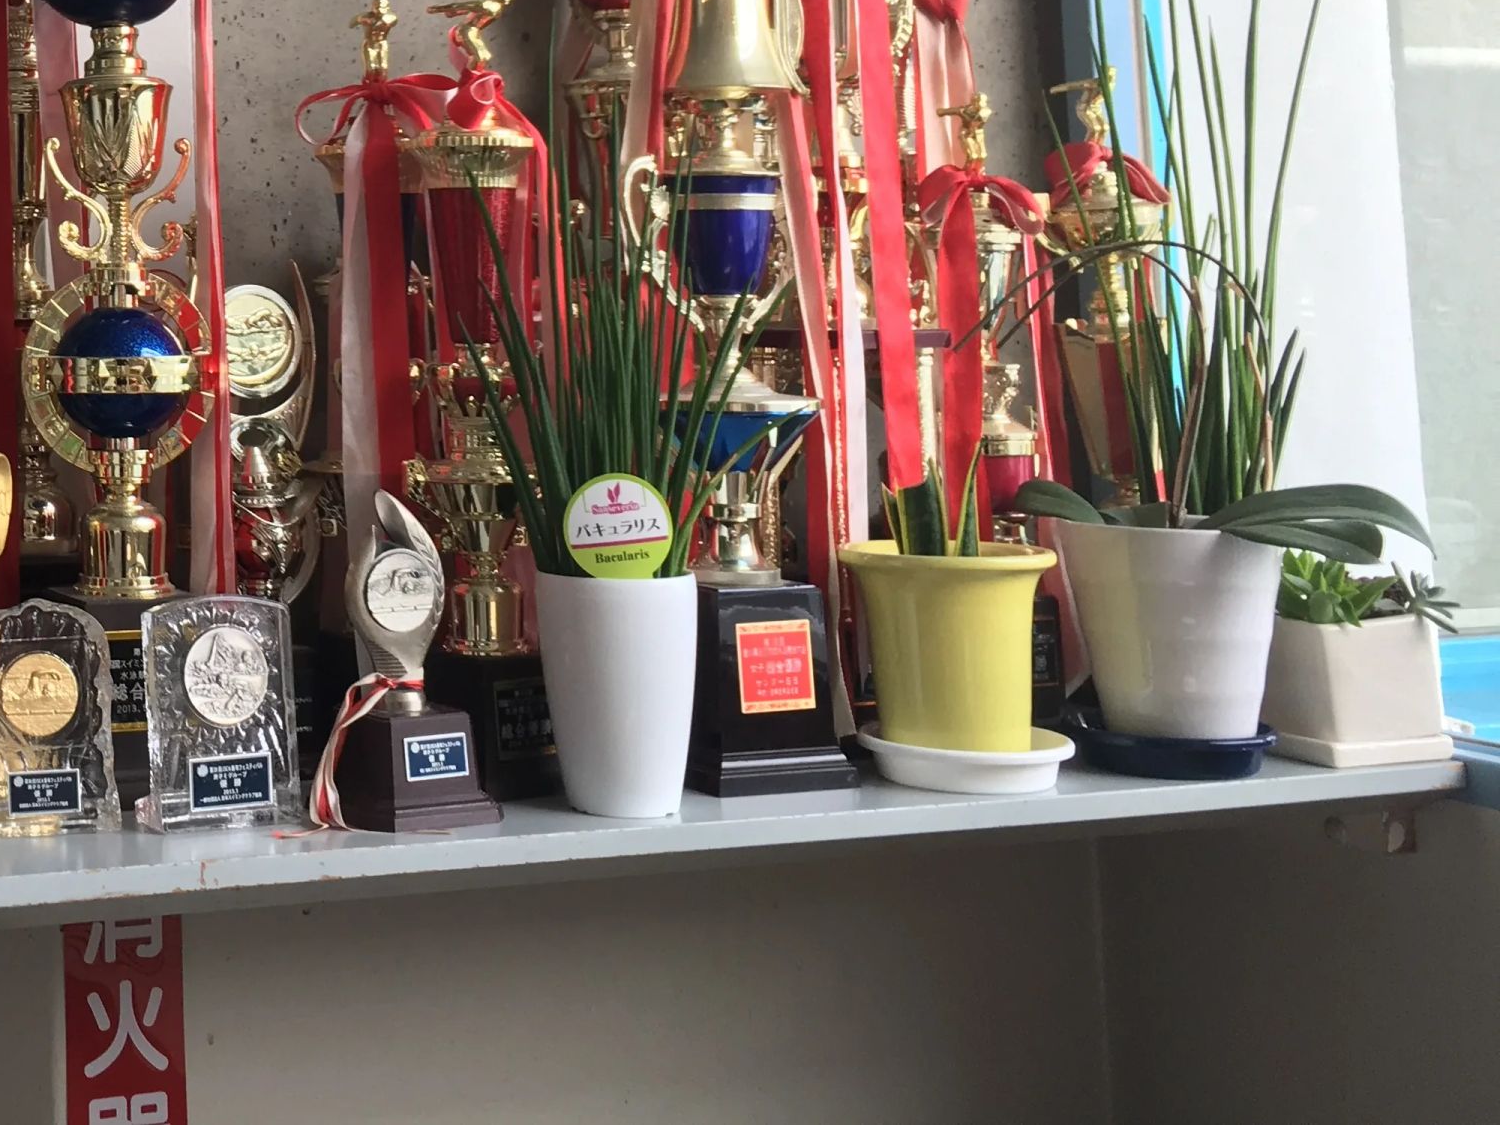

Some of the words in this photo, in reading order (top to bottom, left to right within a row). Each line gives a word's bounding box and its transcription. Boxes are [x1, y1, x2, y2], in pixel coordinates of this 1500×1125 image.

[576, 518, 660, 538] バキュラリス
[595, 549, 650, 563] Bacularis
